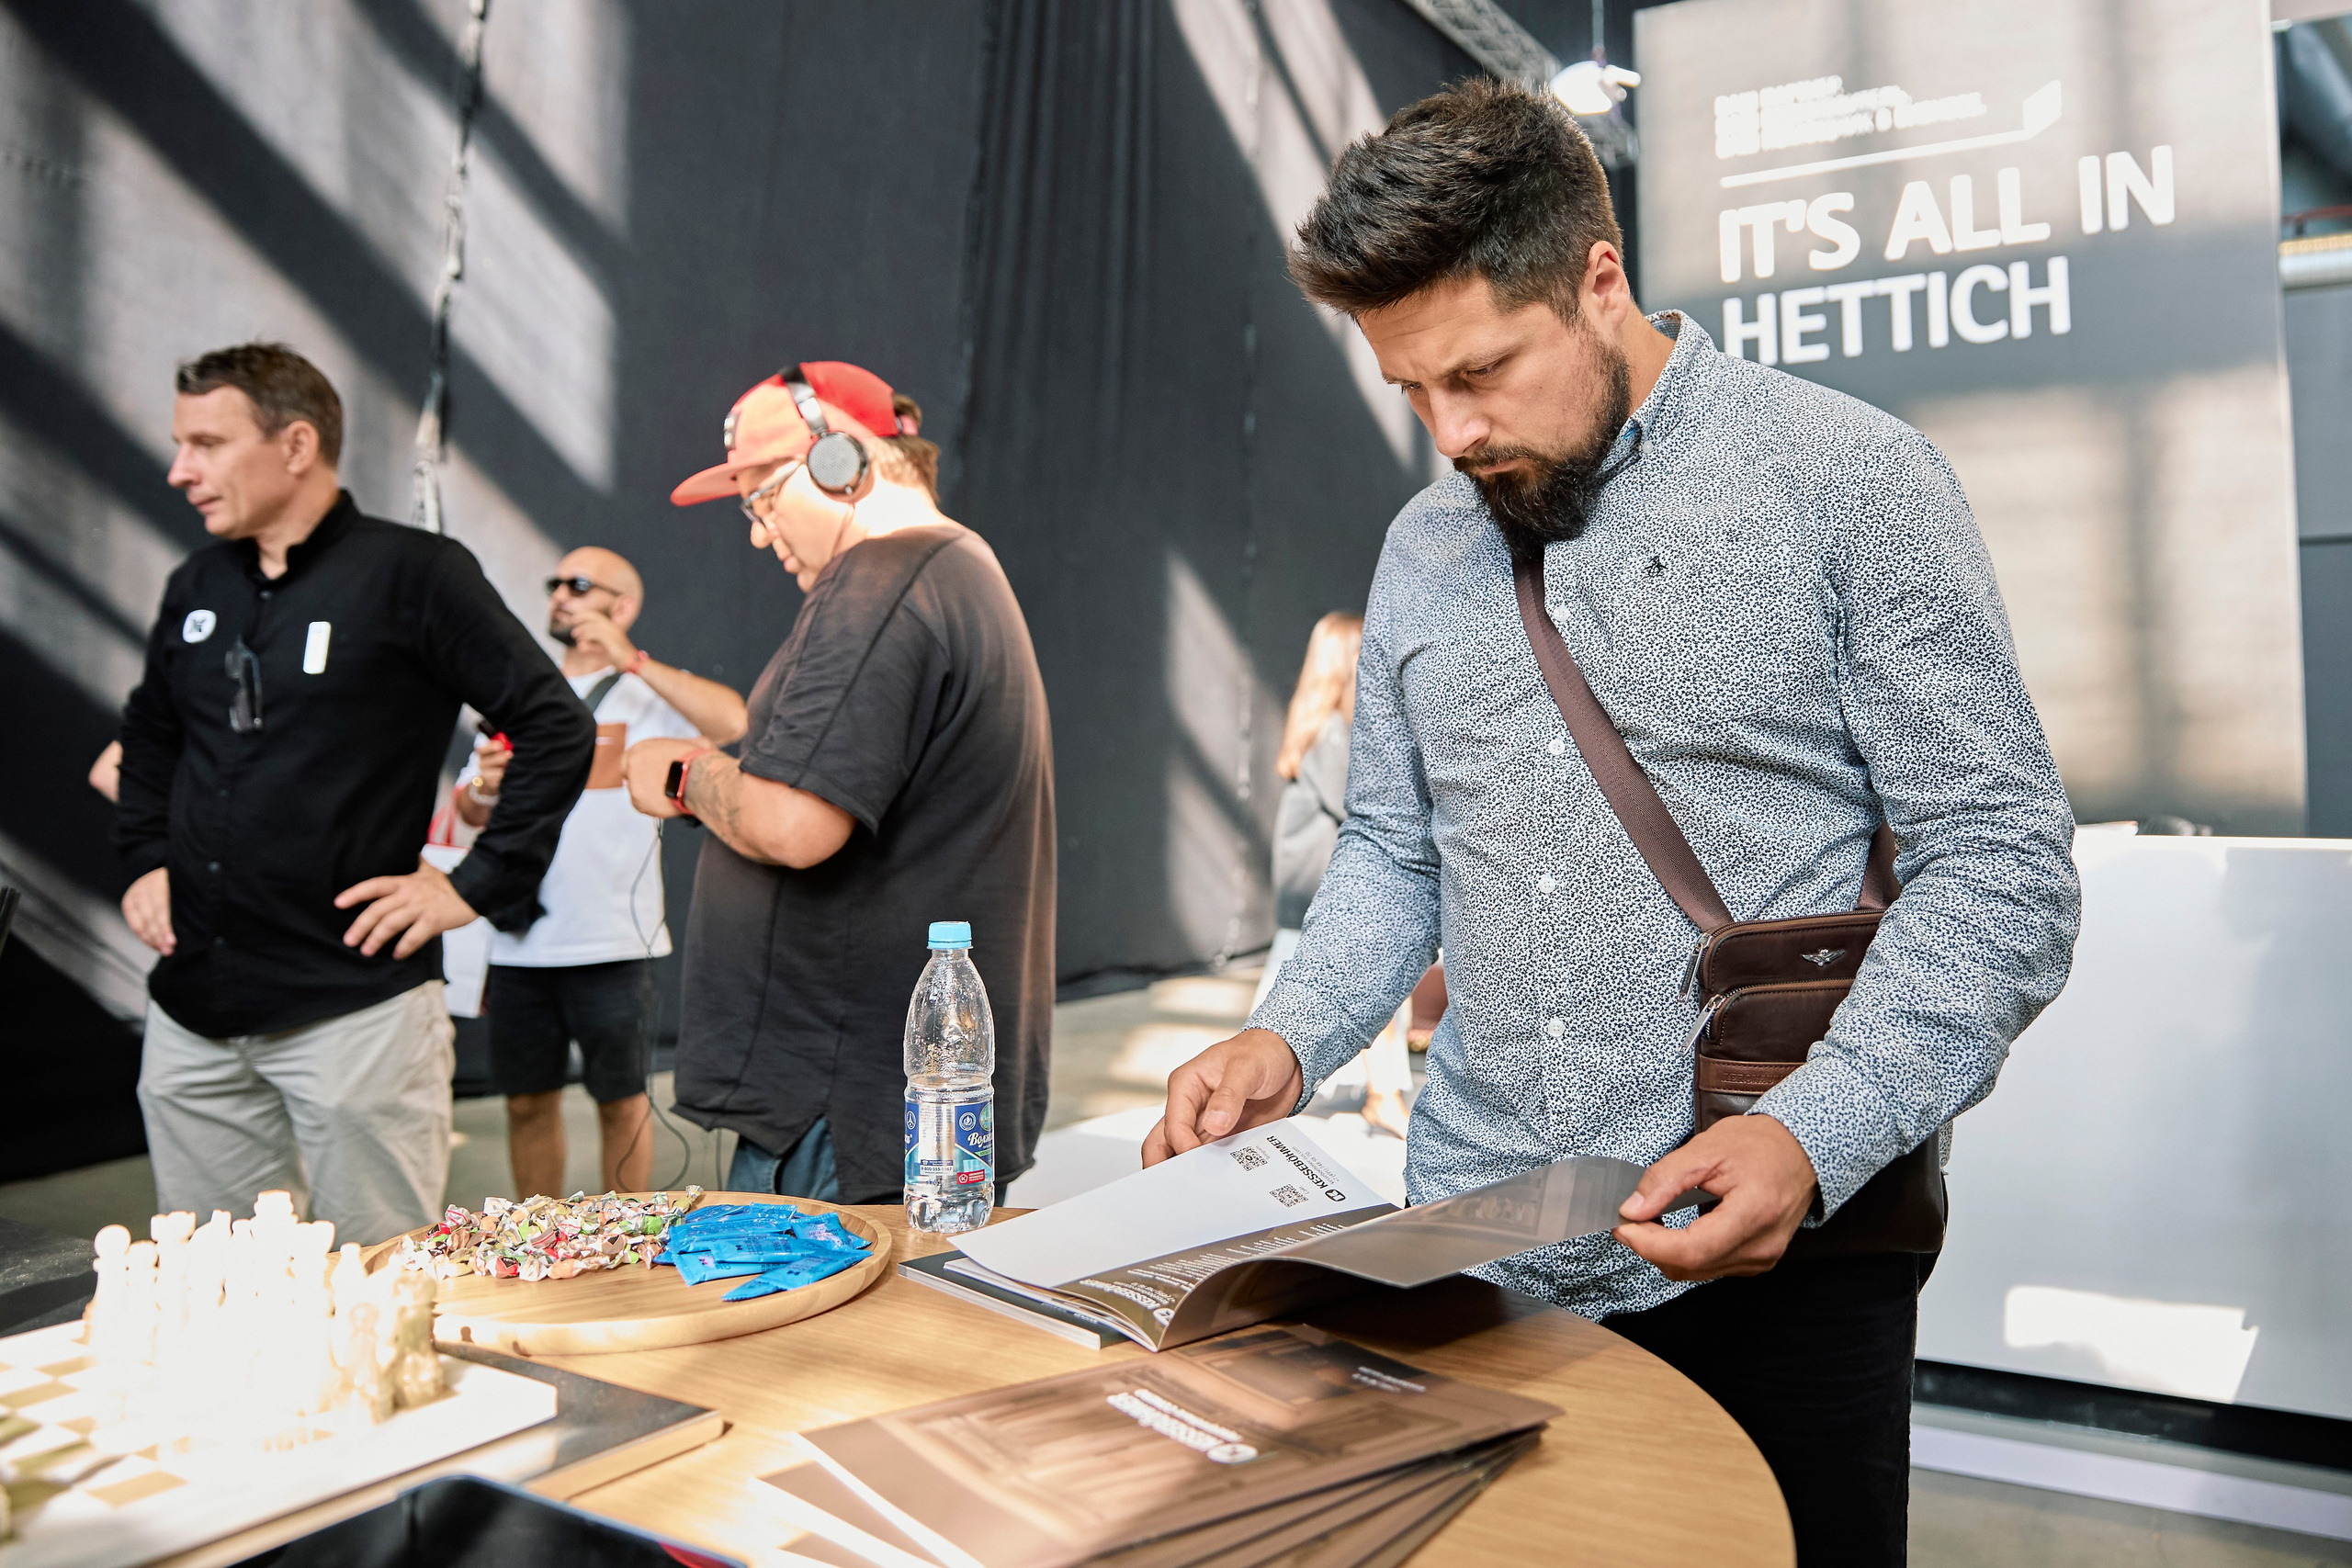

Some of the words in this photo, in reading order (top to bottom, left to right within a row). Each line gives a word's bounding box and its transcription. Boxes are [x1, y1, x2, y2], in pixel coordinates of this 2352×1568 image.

[1719, 192, 1860, 283] IT'S
[1884, 167, 2051, 262] ALL
[2078, 145, 2176, 235] IN
[1722, 255, 2072, 367] HETTICH
[1266, 1135, 1329, 1190] KESSEBÖHMER
